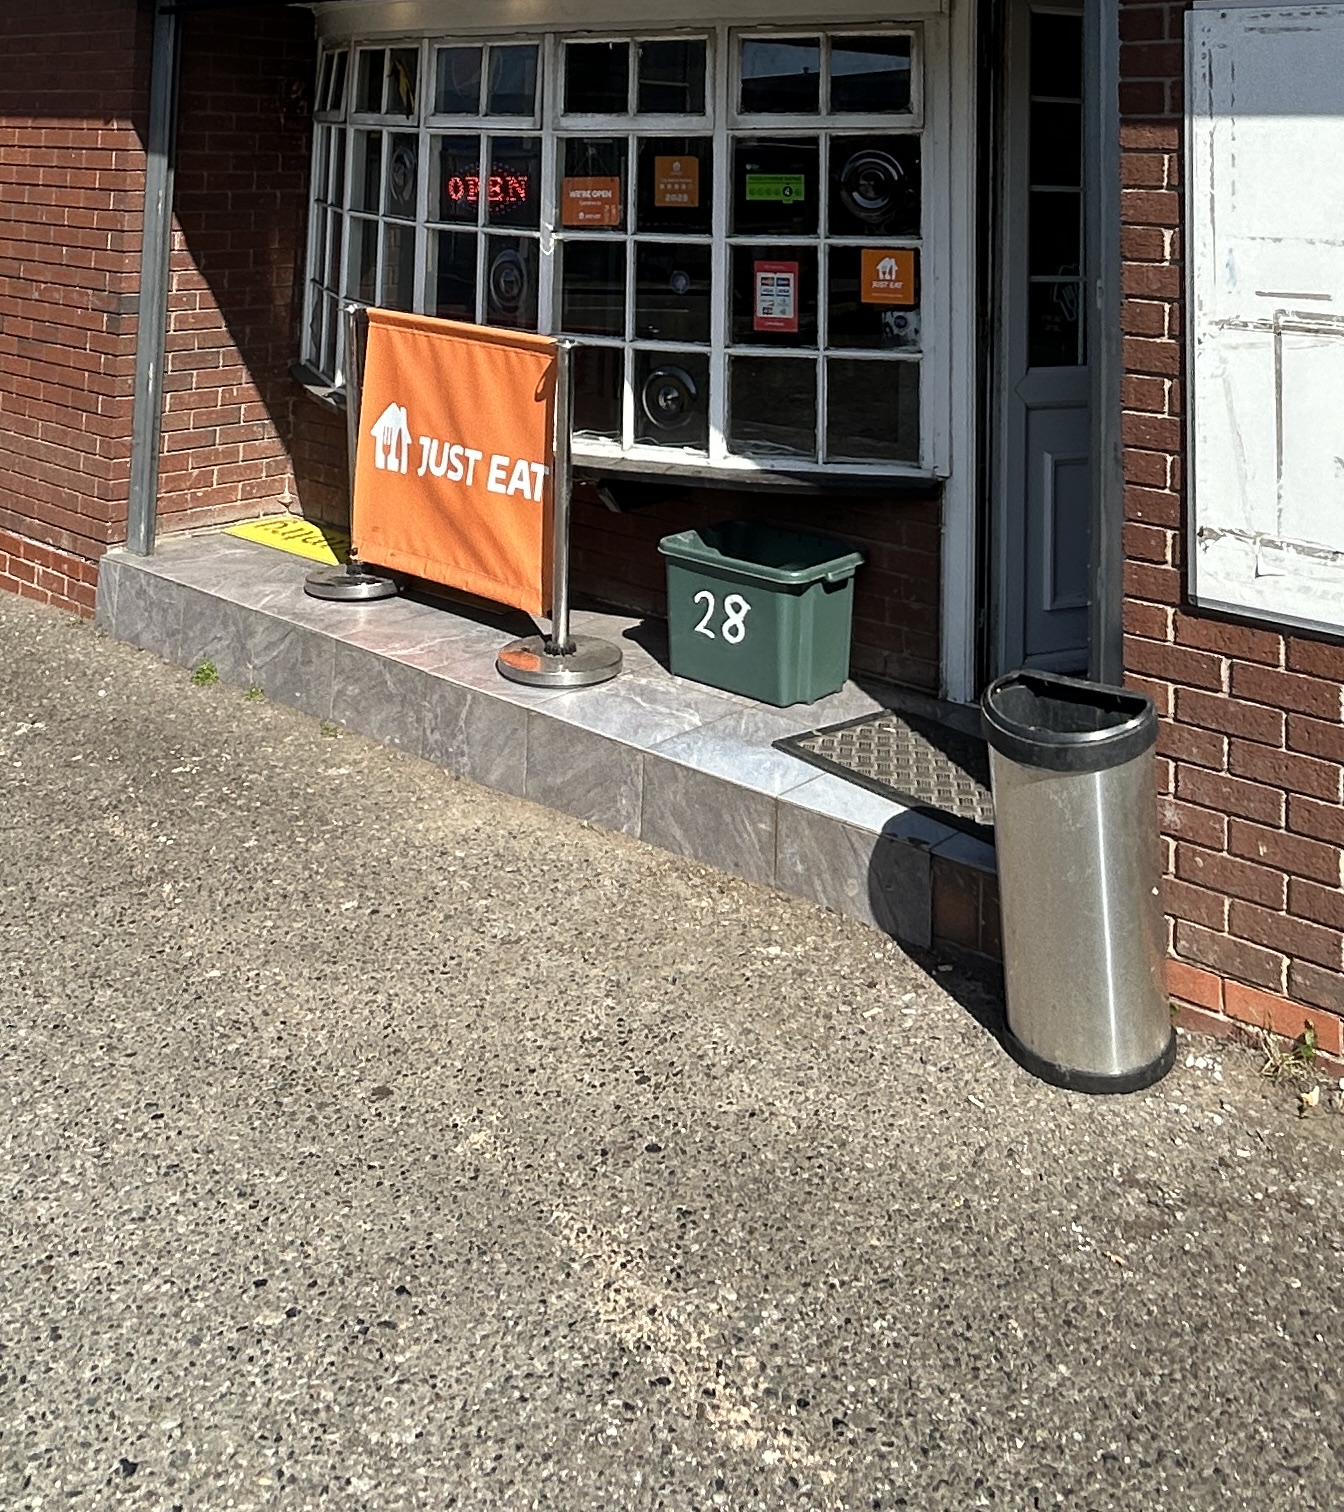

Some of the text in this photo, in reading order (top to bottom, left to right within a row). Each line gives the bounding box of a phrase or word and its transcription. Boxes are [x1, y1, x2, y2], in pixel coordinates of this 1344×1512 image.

[448, 176, 528, 201] OPEN
[417, 436, 549, 502] JUST EAT
[693, 590, 751, 644] 28
